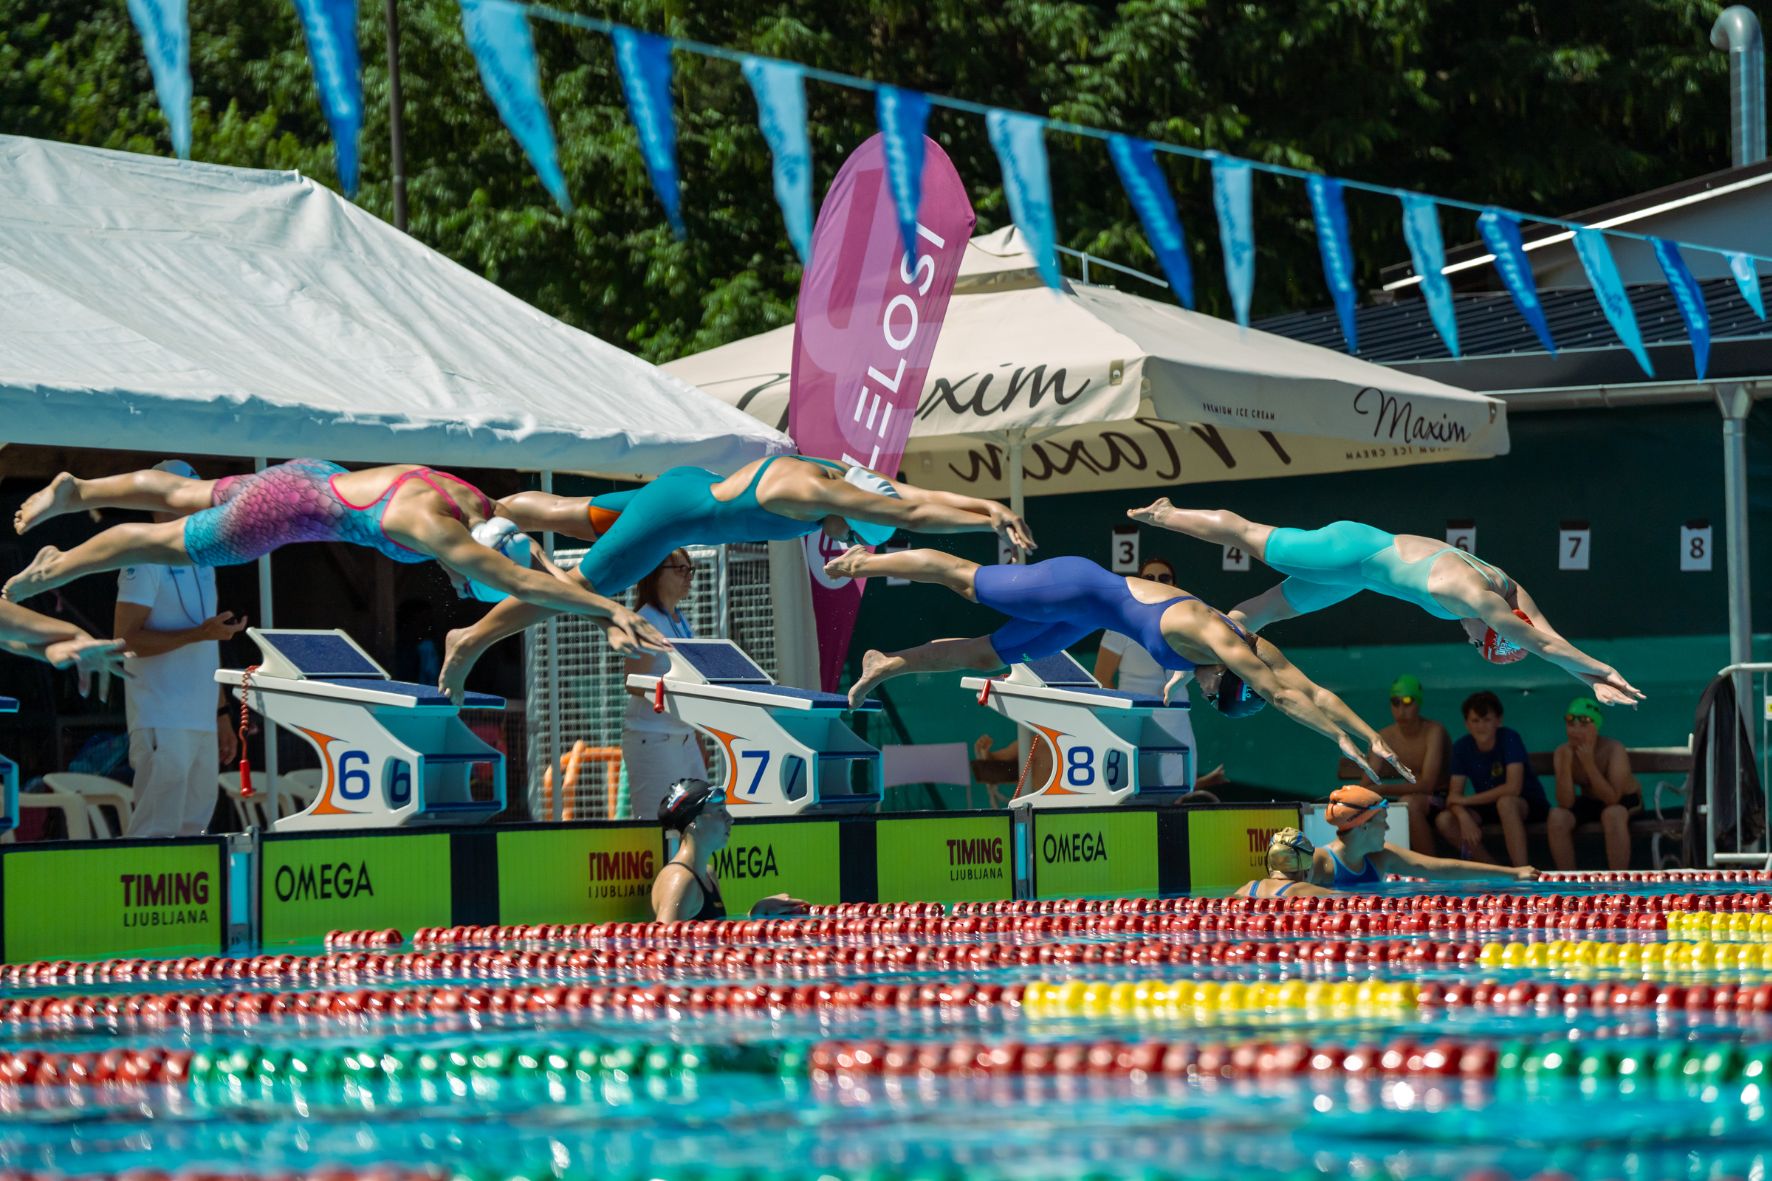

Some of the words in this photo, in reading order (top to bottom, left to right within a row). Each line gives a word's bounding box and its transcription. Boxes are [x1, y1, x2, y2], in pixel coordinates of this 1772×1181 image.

[1203, 402, 1232, 416] PREMIUM
[1236, 407, 1248, 418] ICE
[1252, 409, 1275, 420] CREAM
[1354, 387, 1471, 443] Maxim
[1119, 541, 1134, 565] 3
[1226, 546, 1243, 564] 4
[1568, 537, 1582, 559] 7
[1690, 537, 1704, 559] 8
[339, 750, 371, 800] 6
[741, 750, 770, 794] 7
[1067, 746, 1095, 786] 8
[947, 837, 1003, 865] TIMING
[1043, 832, 1107, 863] OMEGA
[589, 850, 654, 881] TIMING
[950, 867, 1003, 881] LJUBLJANA
[120, 871, 209, 907] TIMING
[275, 861, 374, 902] OMEGA
[123, 910, 208, 928] LJUBLJANA
